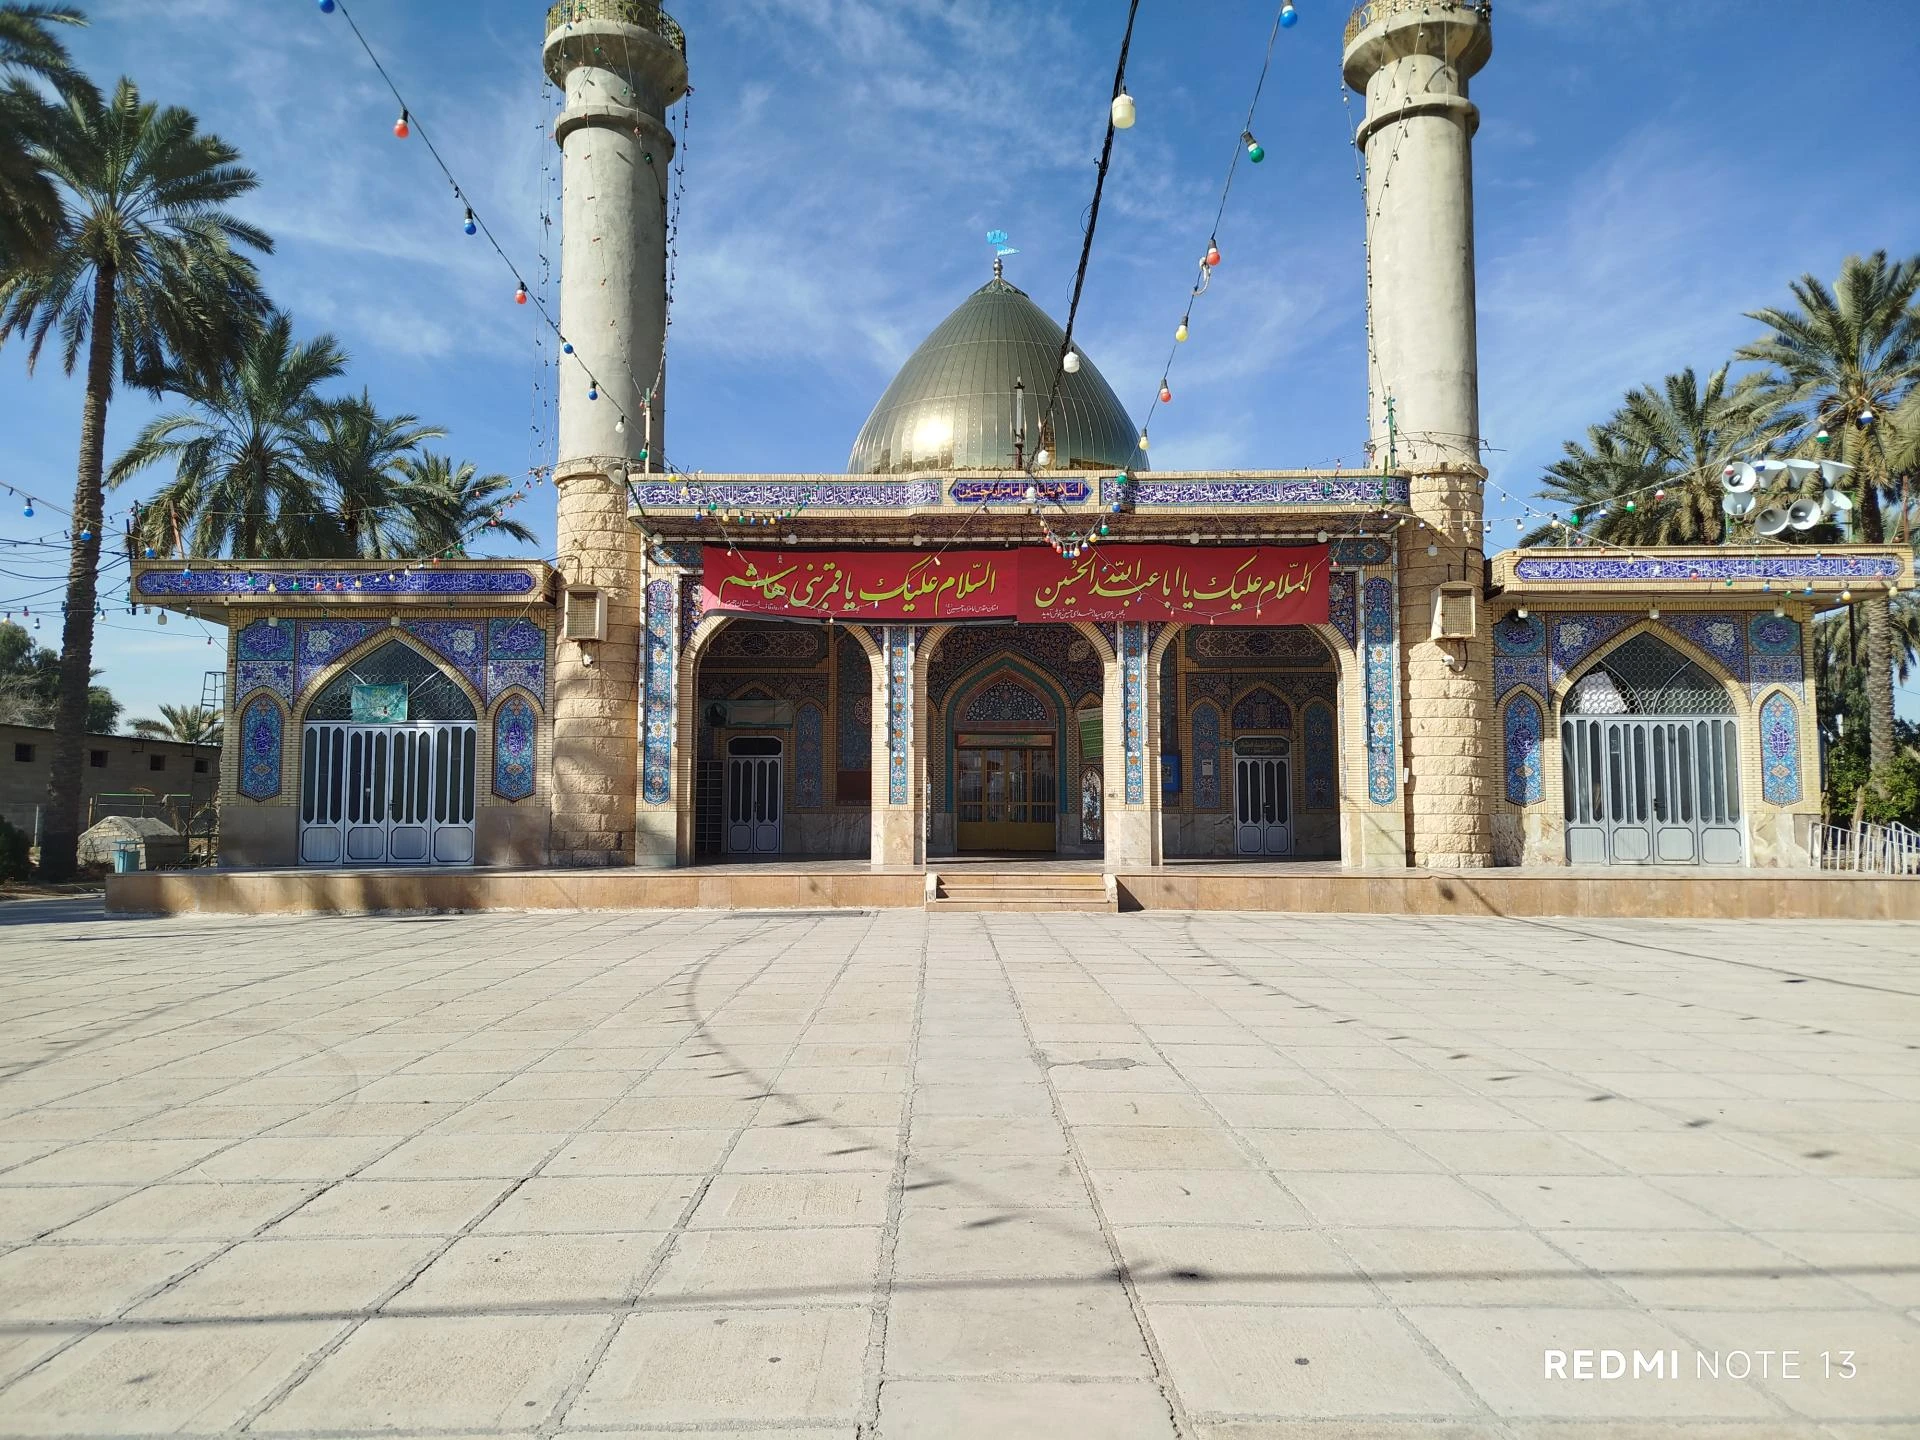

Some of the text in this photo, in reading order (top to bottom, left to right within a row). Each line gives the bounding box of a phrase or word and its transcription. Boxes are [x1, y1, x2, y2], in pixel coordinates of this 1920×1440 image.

[718, 562, 798, 607] هاشم
[813, 562, 843, 608] قمر
[843, 571, 856, 610] یا
[1182, 571, 1194, 609] یا
